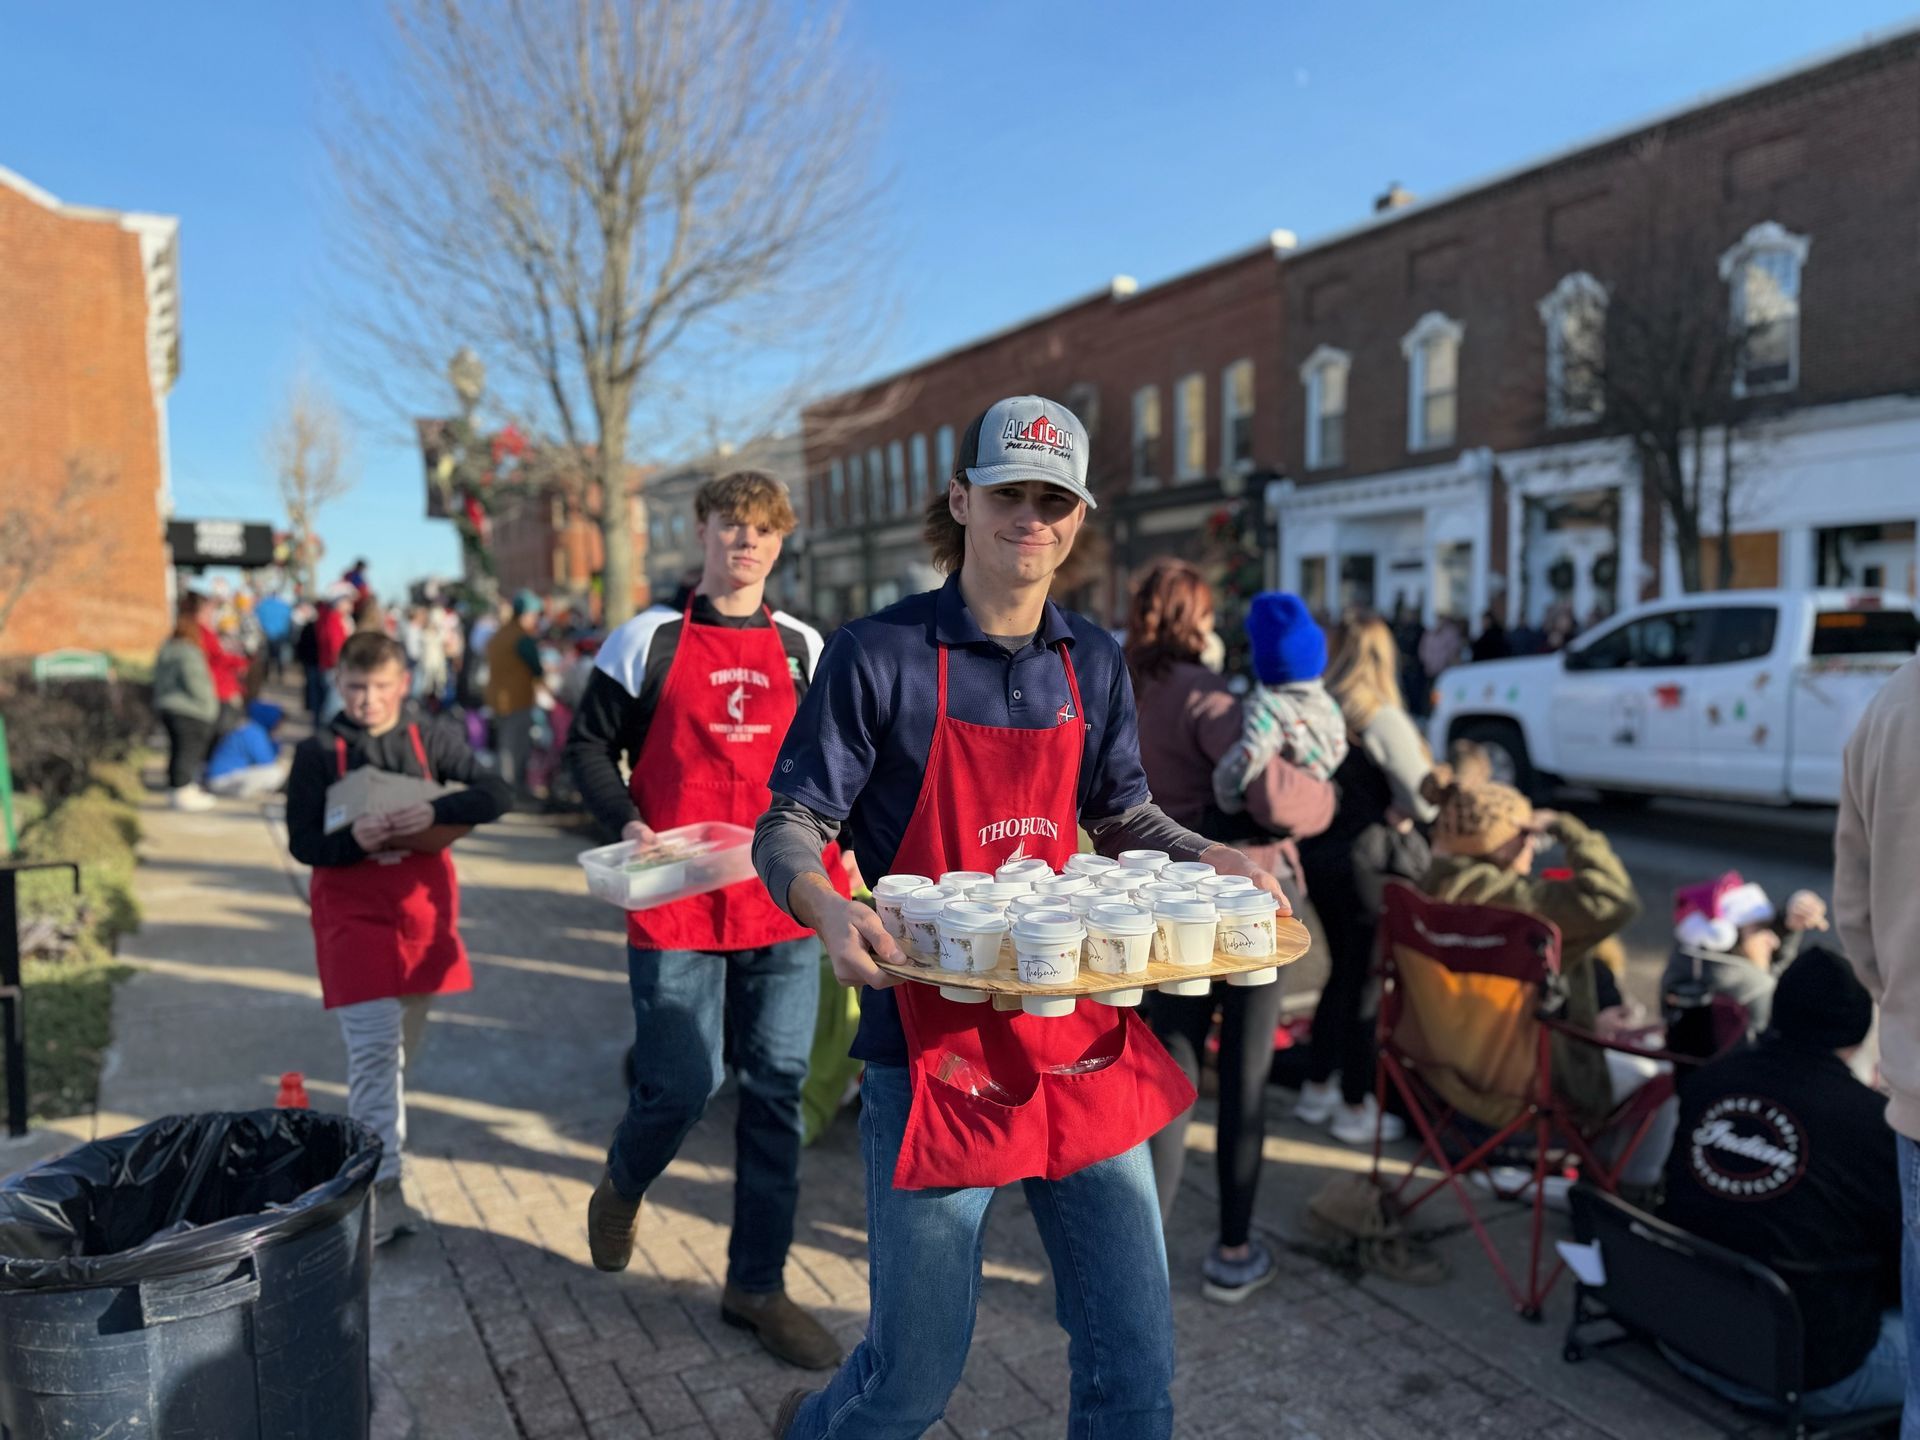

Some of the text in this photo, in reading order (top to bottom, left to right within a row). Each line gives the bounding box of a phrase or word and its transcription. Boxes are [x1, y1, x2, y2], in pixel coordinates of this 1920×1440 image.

[1003, 418, 1073, 450] ALLICON
[1049, 446, 1071, 460] TEAM
[709, 667, 769, 689] THOBURN
[978, 817, 1058, 847] THOBURN
